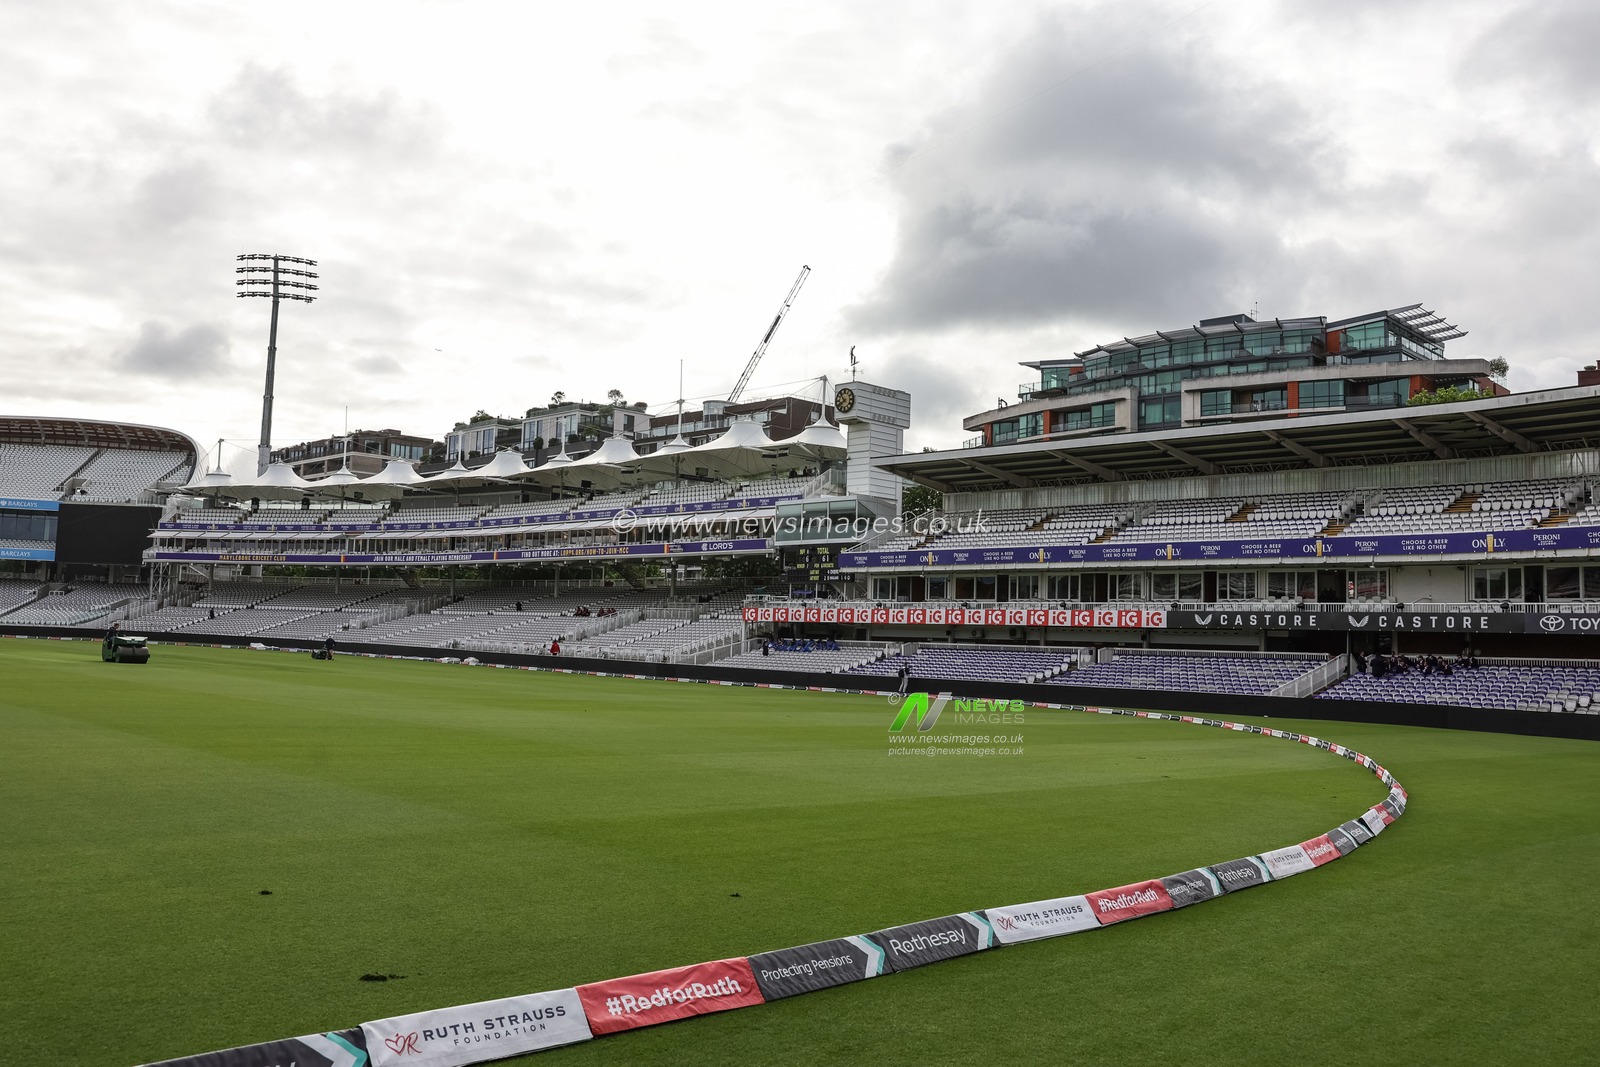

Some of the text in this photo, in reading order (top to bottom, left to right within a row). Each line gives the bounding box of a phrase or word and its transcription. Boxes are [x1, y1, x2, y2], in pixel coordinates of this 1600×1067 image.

[709, 542, 734, 550] LORD'S
[1220, 614, 1317, 627] CASTORE
[1379, 616, 1489, 629] CASTORE
[1570, 618, 1600, 630] TOY
[1218, 867, 1256, 882] Rothesay
[1098, 888, 1159, 912] #RedforRuth
[1014, 905, 1084, 922] RUTH STRAUSS
[1031, 916, 1075, 926] FOUNDATION
[889, 928, 966, 956] Rothesay
[761, 954, 853, 982] Protecting Pensions
[606, 976, 742, 1016] #RedforRuth
[422, 1006, 566, 1041] RUTH STRAUSS
[454, 1023, 546, 1045] FOUNDATION
